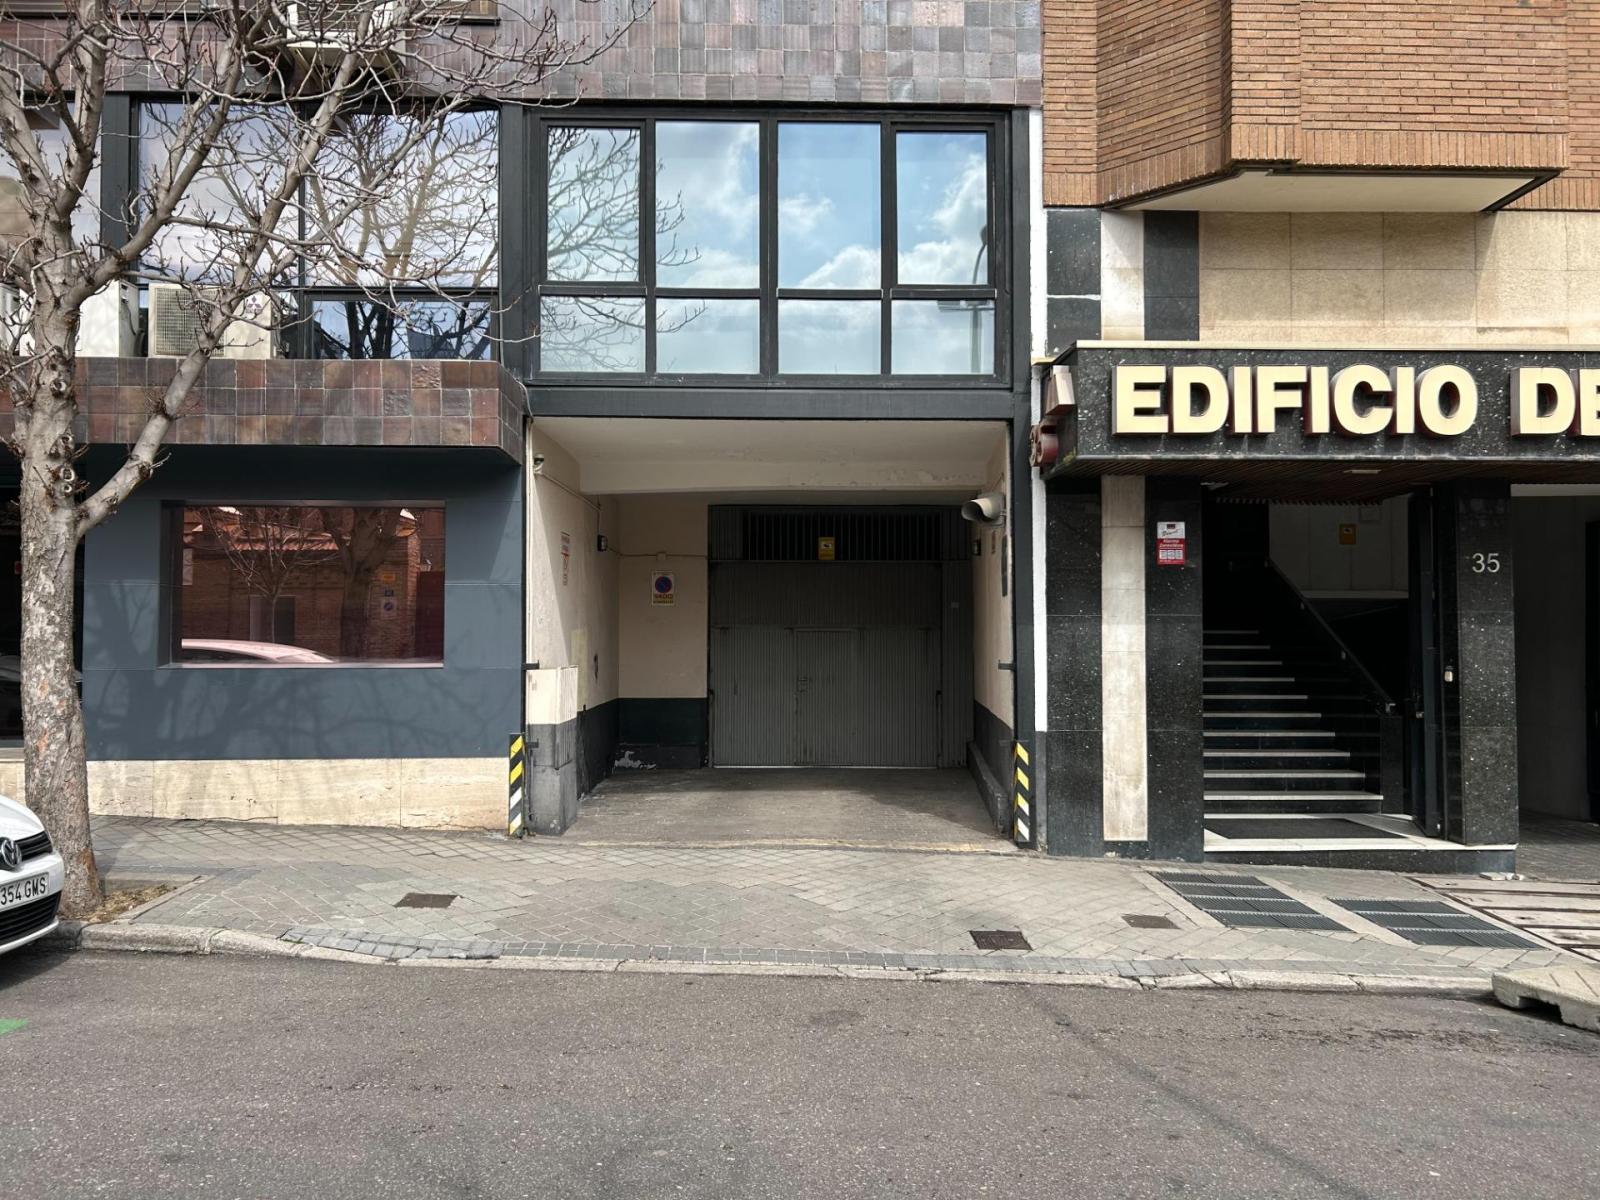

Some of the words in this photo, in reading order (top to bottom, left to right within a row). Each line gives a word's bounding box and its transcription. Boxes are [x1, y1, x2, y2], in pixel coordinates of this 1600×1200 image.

[1113, 364, 1479, 436] EDIFICIO
[1472, 553, 1501, 573] 35
[0, 883, 22, 905] 354
[25, 877, 46, 898] GMS
